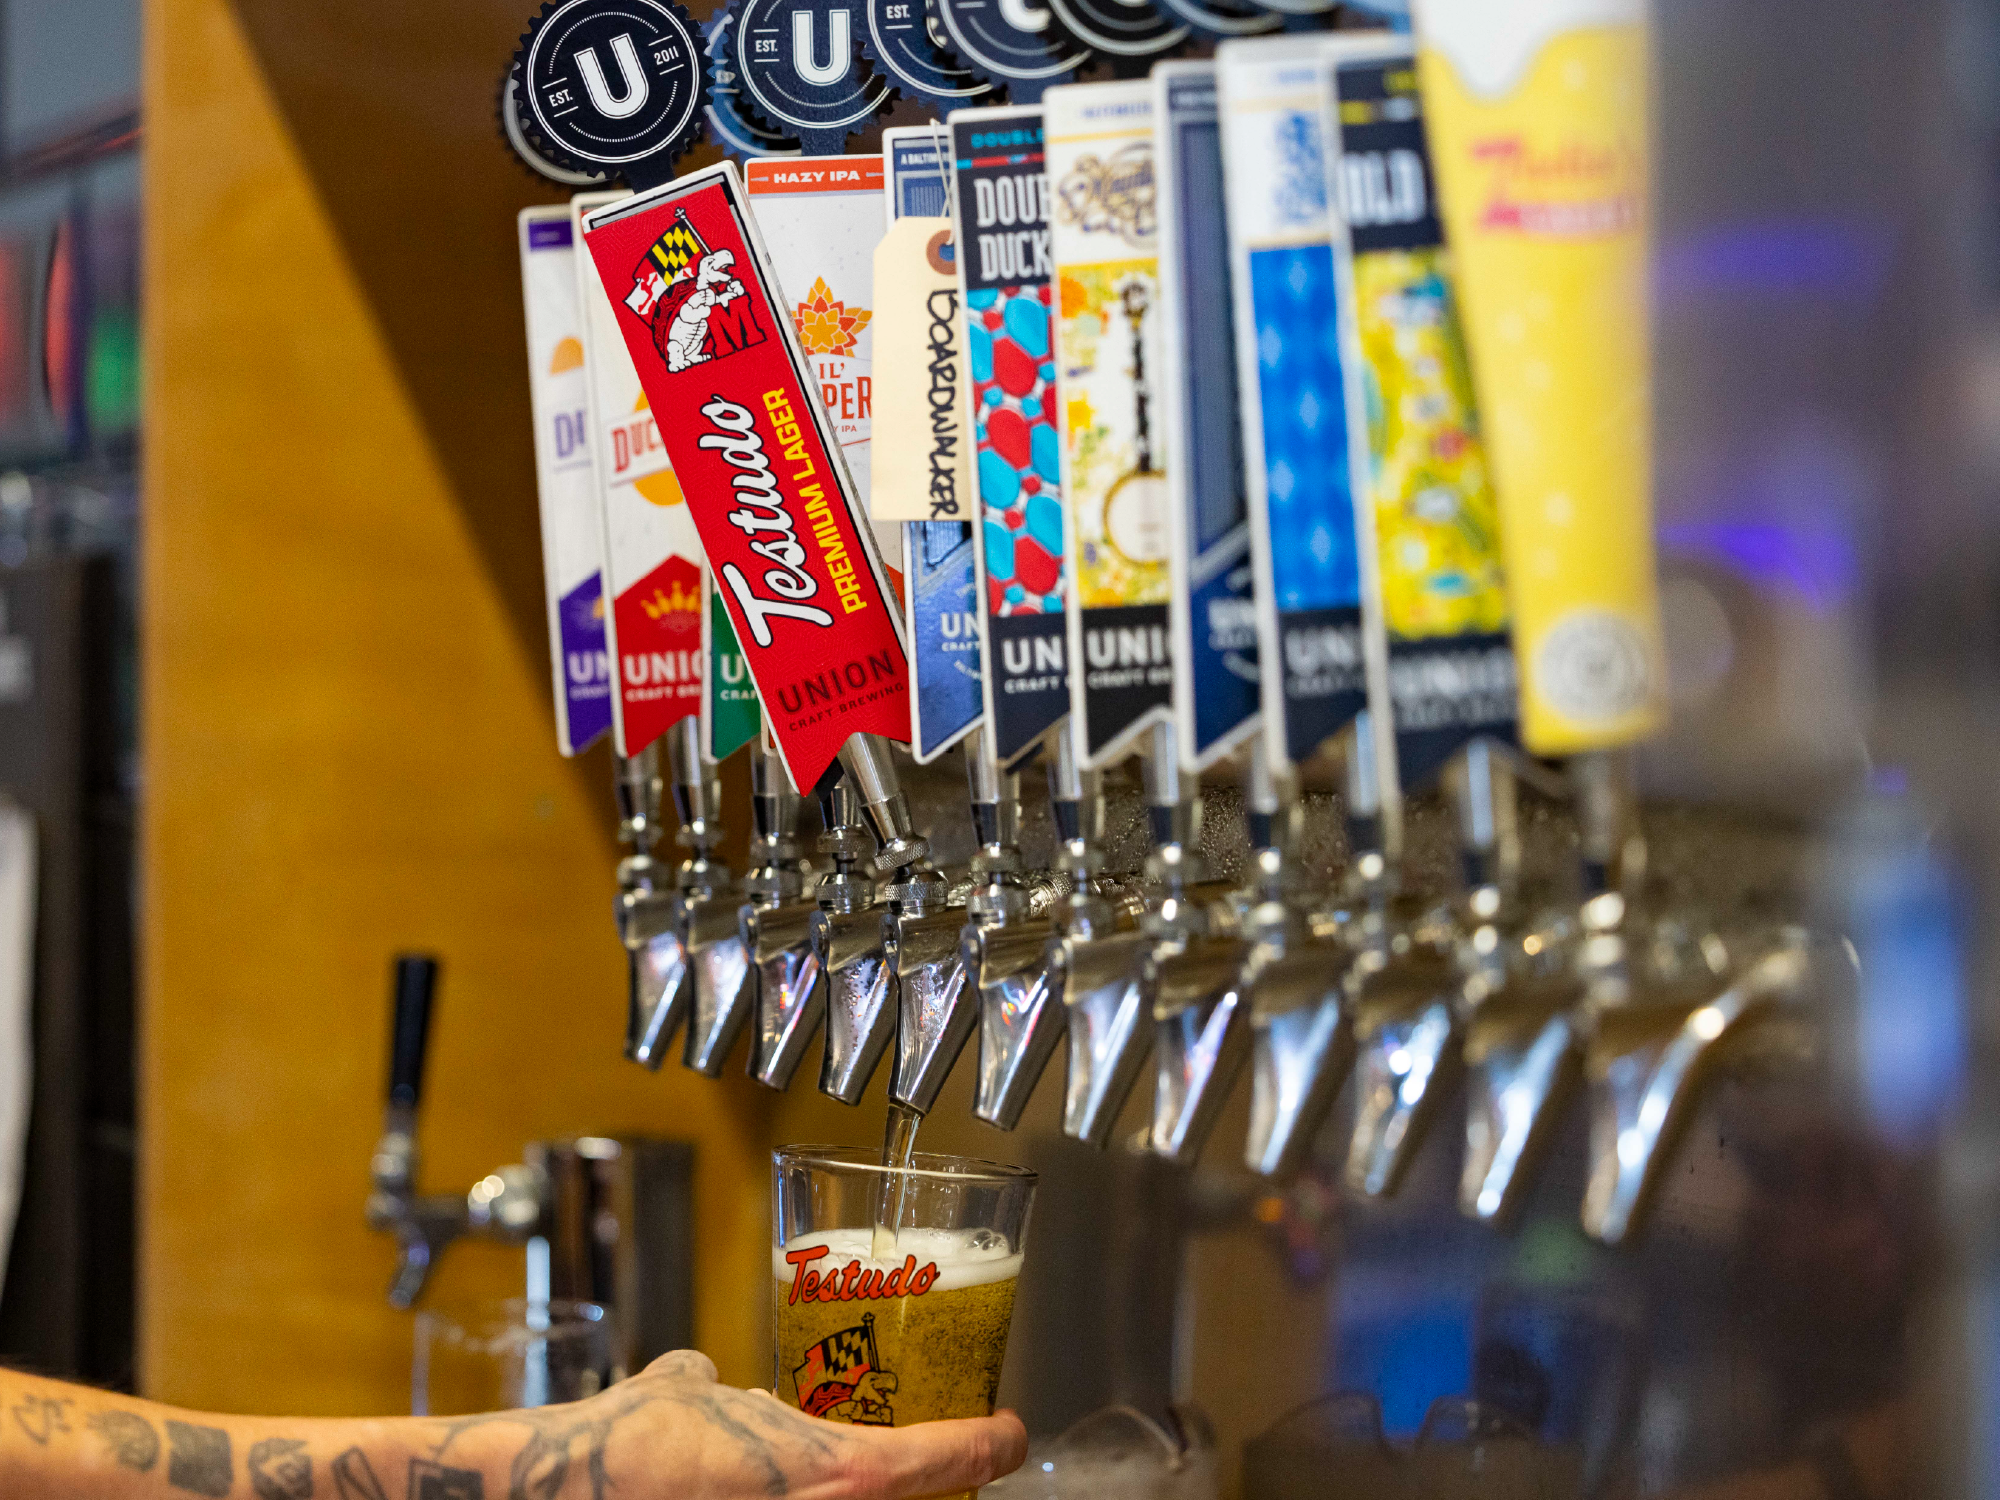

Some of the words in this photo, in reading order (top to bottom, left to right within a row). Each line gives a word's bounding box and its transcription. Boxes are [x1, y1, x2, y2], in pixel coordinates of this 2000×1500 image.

[886, 5, 911, 19] EST.
[654, 46, 679, 66] 2011
[755, 39, 778, 52] EST.
[792, 9, 850, 86] U
[549, 89, 573, 108] EST.
[573, 33, 649, 119] U
[774, 171, 825, 183] HAZY
[830, 170, 860, 182] IPA
[762, 387, 816, 480] LAGER
[841, 425, 857, 433] IPA
[697, 393, 834, 648] Testudo
[798, 483, 868, 614] PREMIUM
[778, 650, 896, 713] UNION
[789, 709, 834, 732] CRAFT
[839, 682, 905, 713] BREWING
[786, 1245, 940, 1306] Testudo
